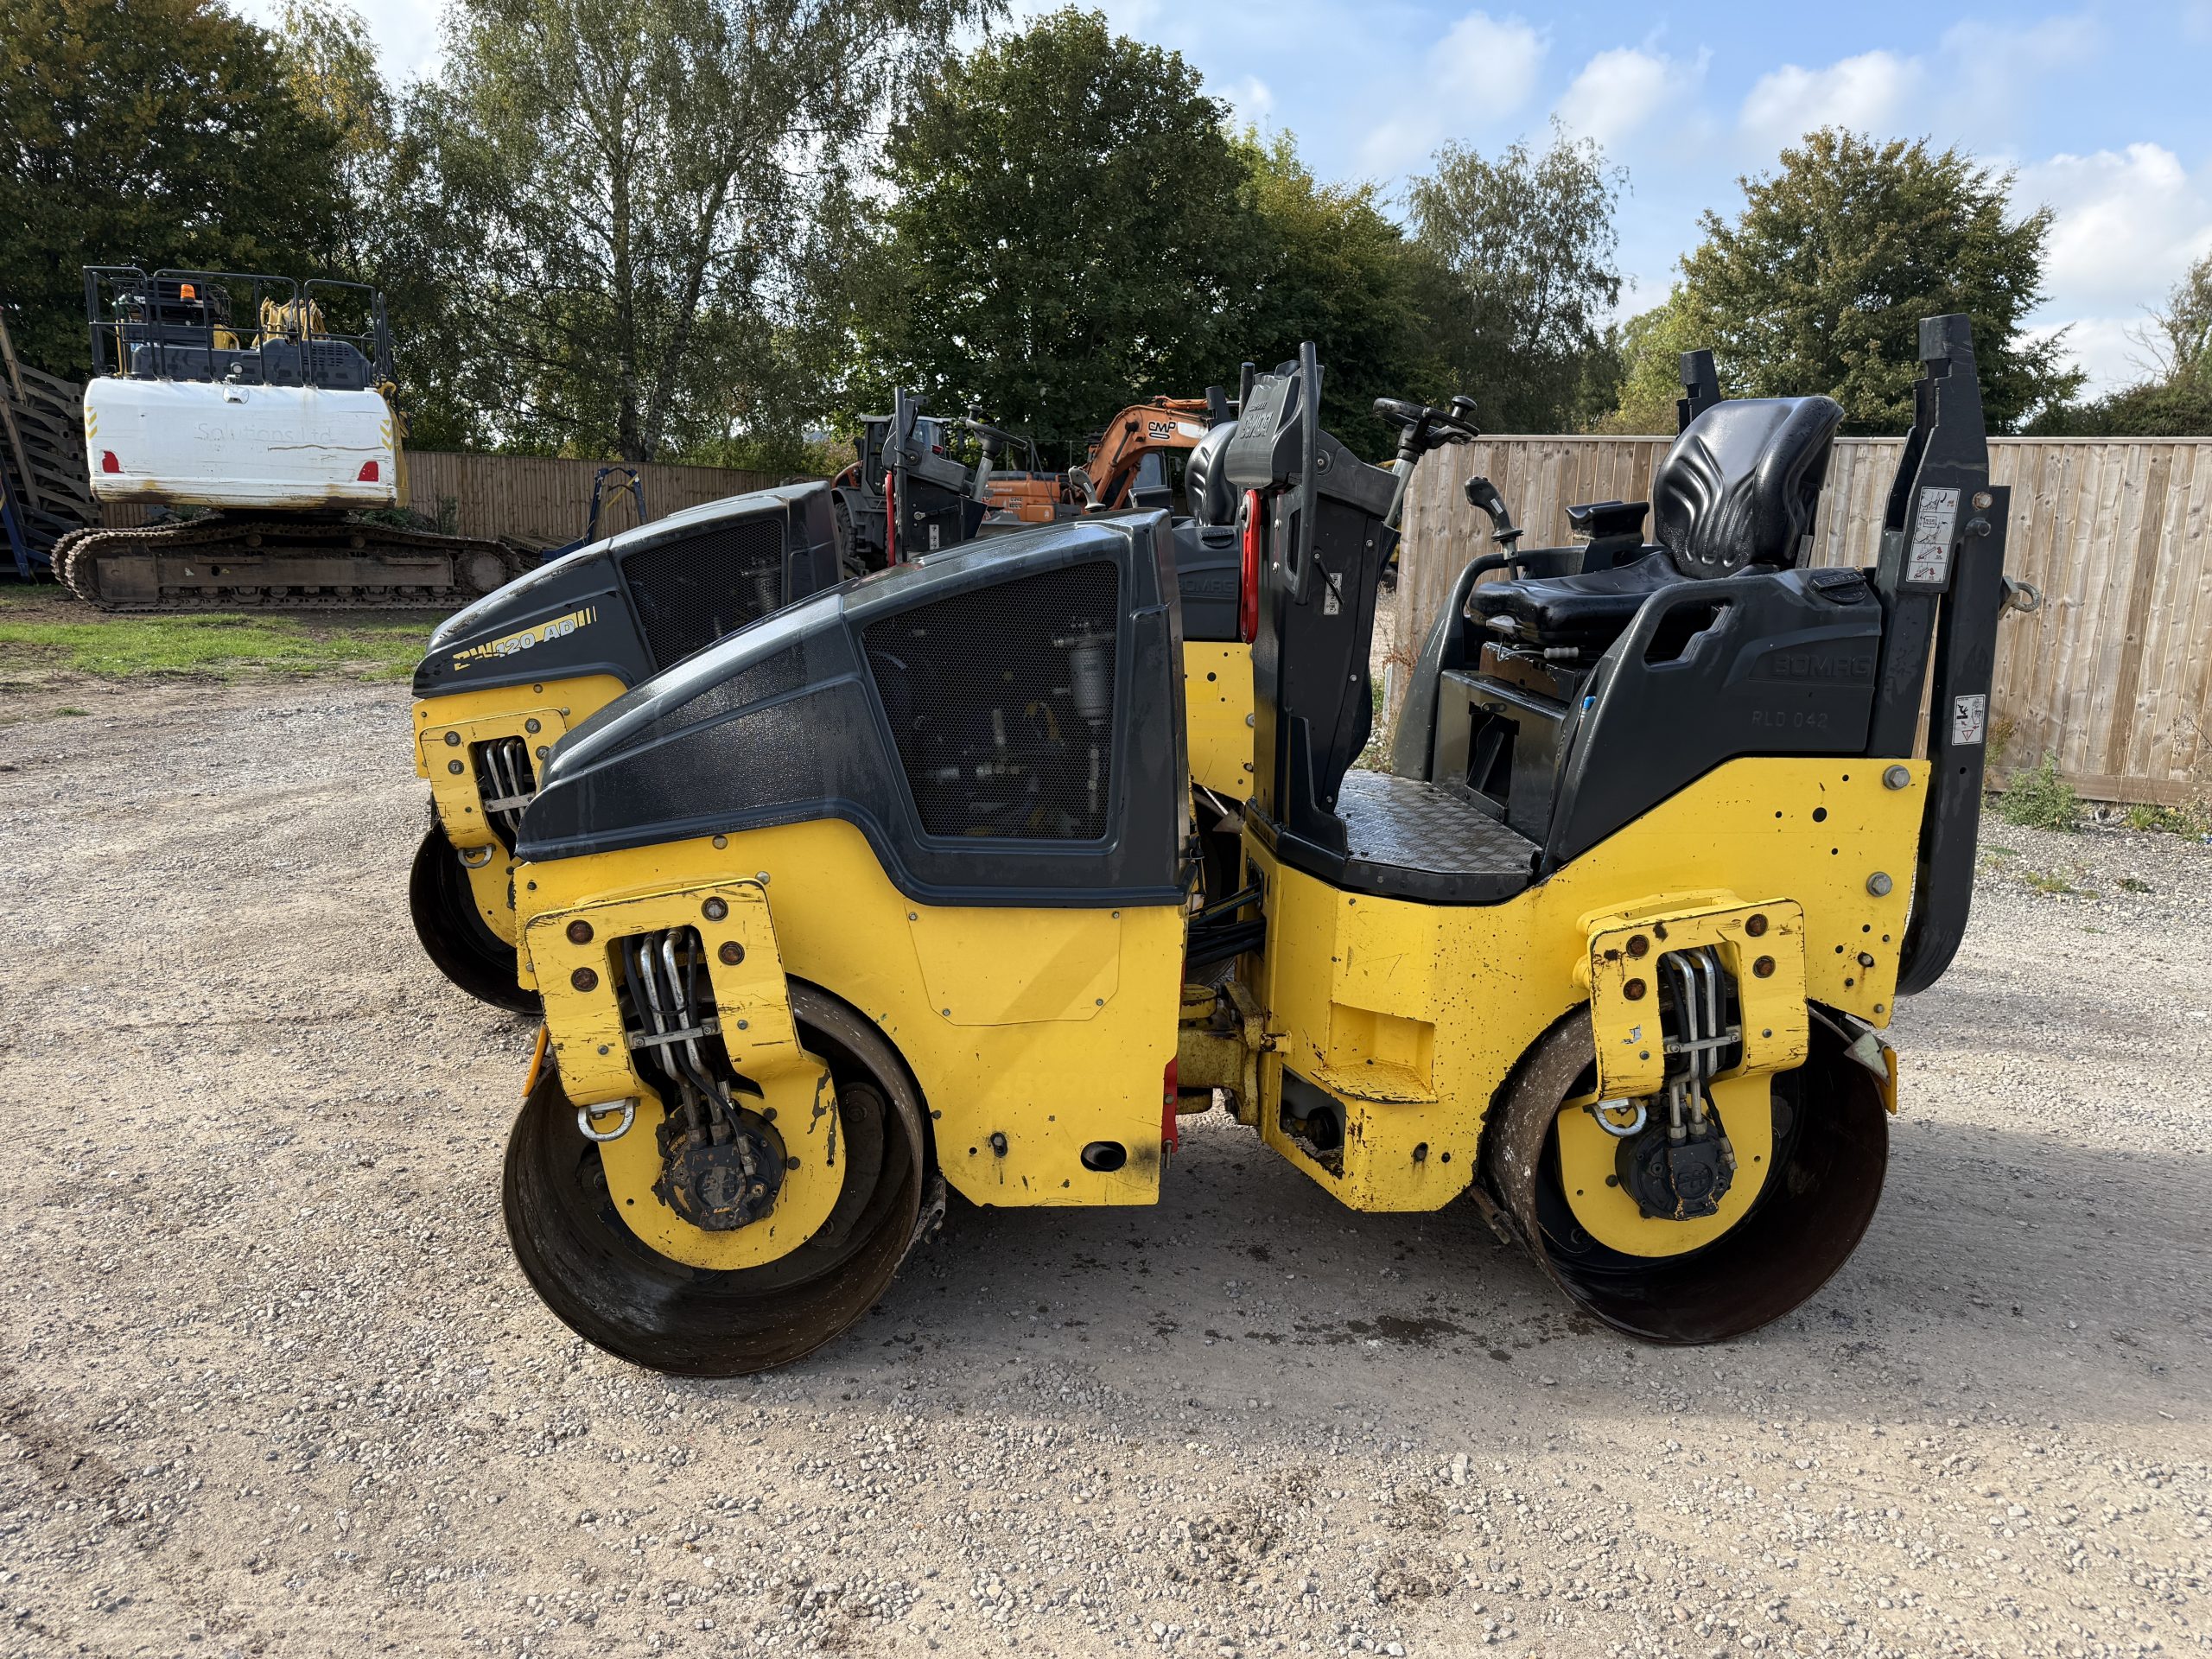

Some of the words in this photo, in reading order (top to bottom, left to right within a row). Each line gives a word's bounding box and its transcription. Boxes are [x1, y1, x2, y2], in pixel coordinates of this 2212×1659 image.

[197, 422, 295, 442] Solutions
[301, 426, 332, 443] Ltd
[1148, 421, 1176, 434] CMP
[543, 619, 575, 643] AD
[1773, 654, 1872, 677] BOMAG
[1752, 710, 1785, 727] RLD
[1794, 712, 1828, 728] 042
